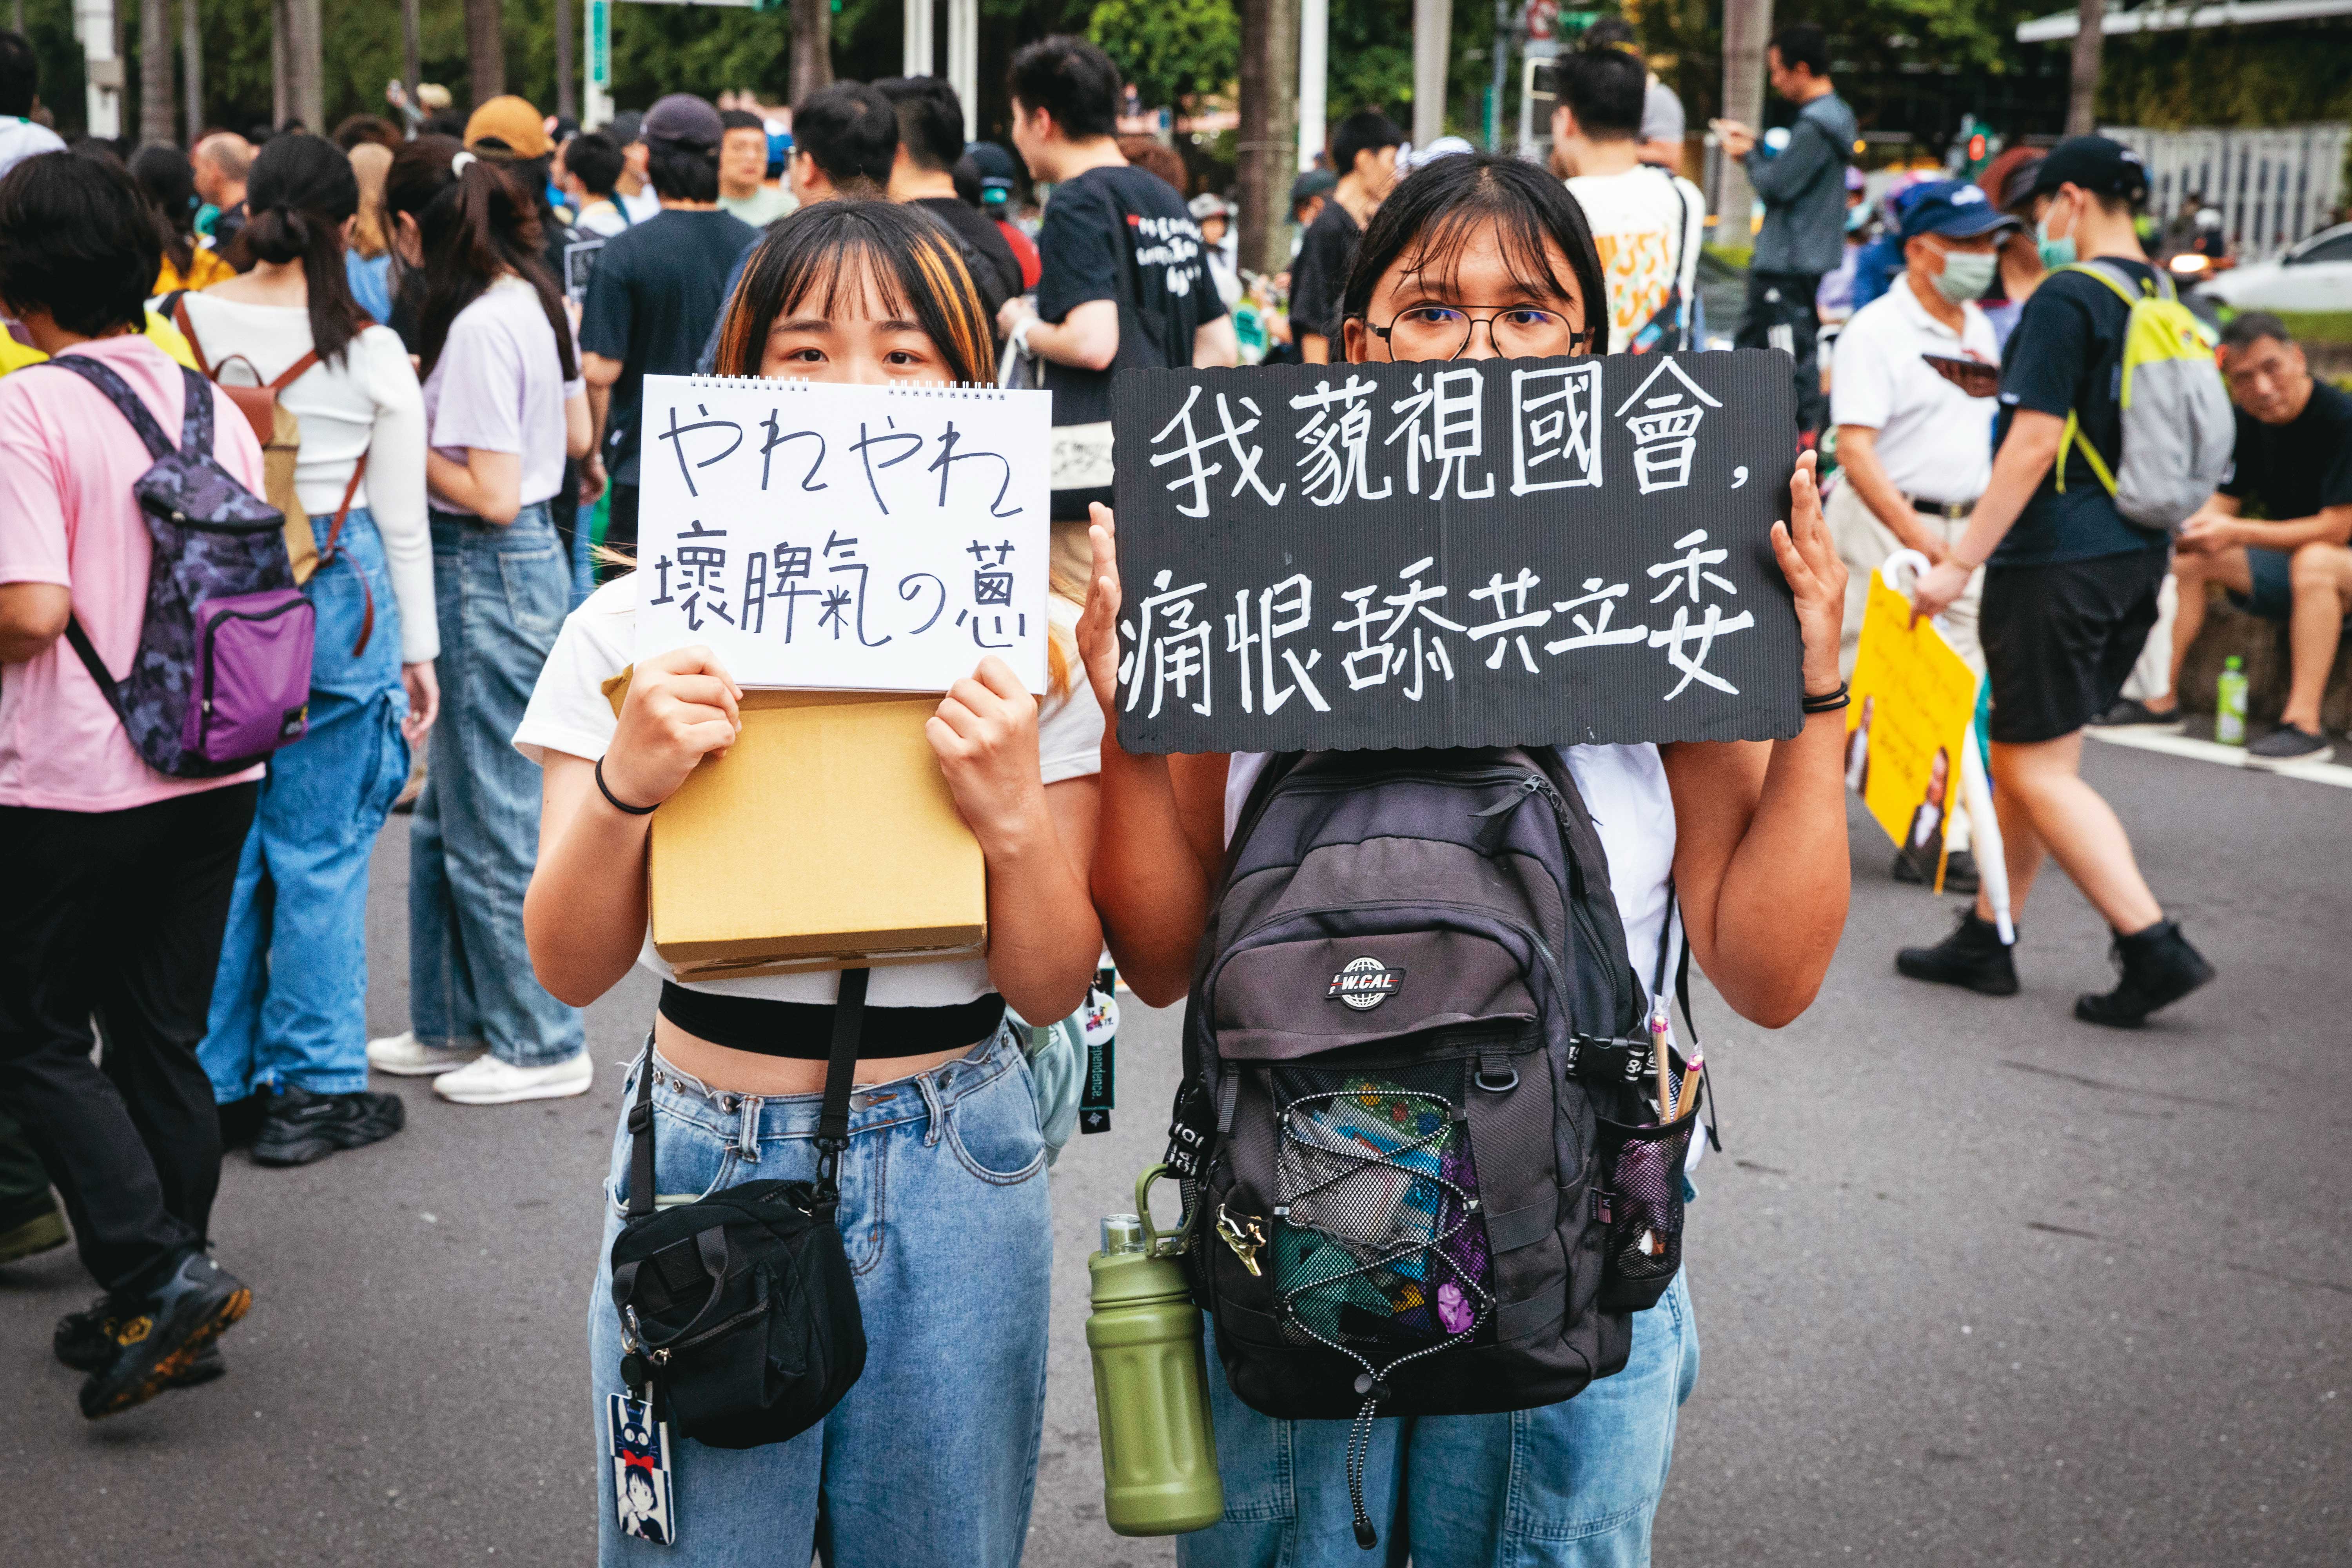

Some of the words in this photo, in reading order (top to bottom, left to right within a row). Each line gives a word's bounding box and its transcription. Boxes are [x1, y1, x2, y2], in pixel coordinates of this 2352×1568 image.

[658, 403, 1024, 518] やれやれ
[1117, 528, 1755, 719] 痛恨舔共立委
[1341, 974, 1392, 990] W.CAL
